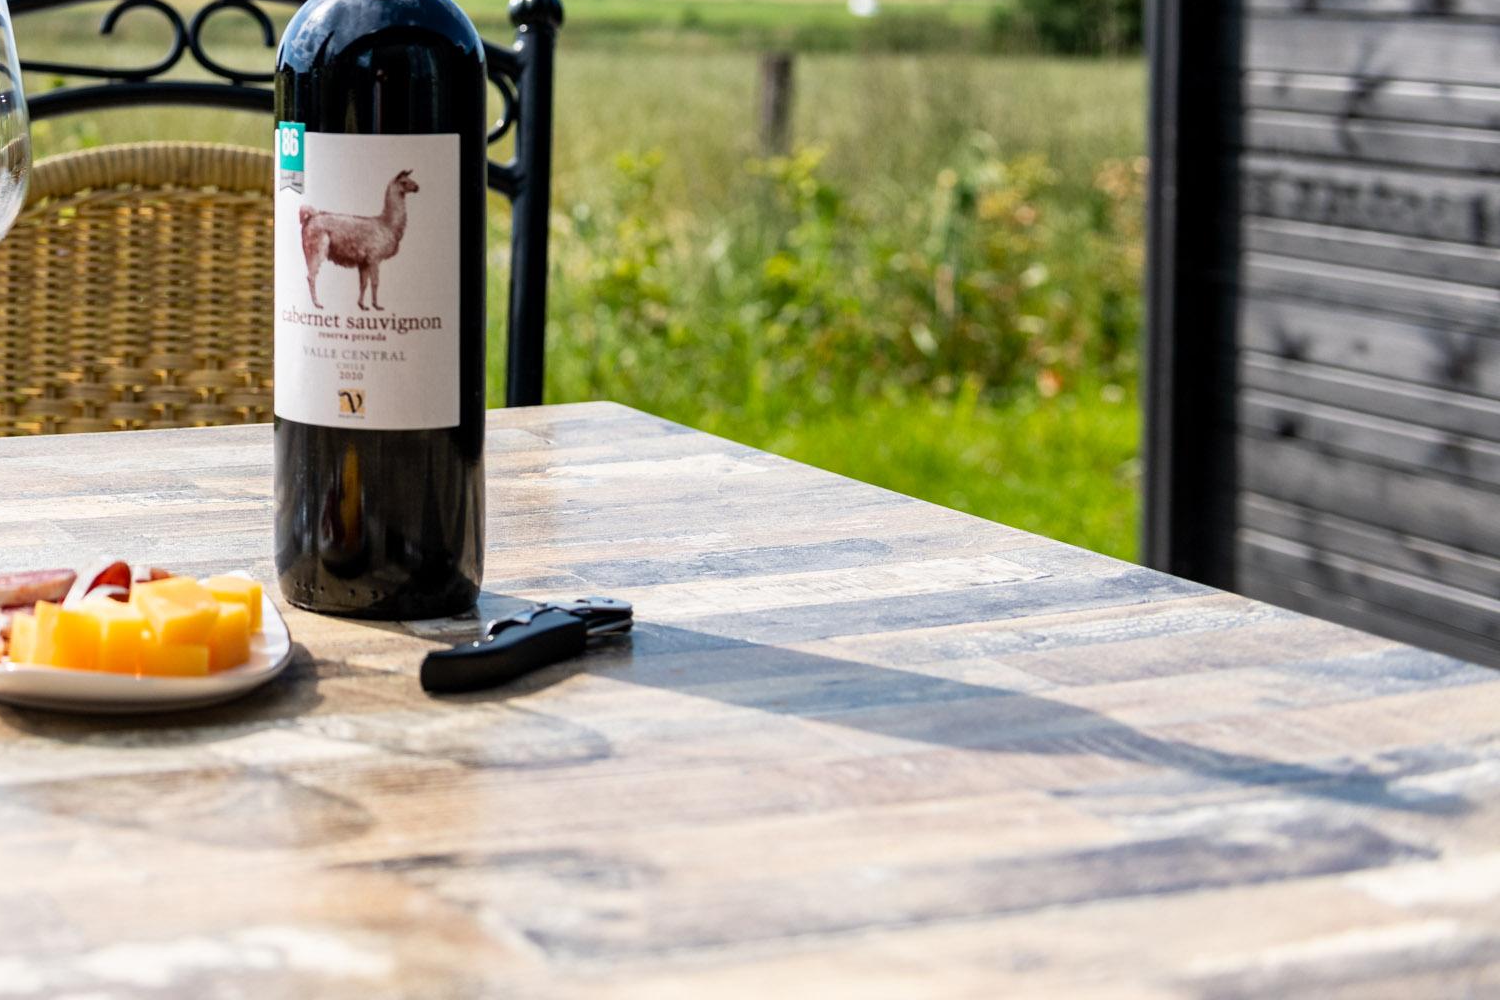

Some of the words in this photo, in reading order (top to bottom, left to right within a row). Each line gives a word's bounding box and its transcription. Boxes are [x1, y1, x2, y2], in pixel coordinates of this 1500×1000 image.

[282, 127, 299, 156] 86
[282, 305, 340, 328] cabernet
[346, 313, 443, 334] sauvignon
[318, 331, 349, 340] reserva
[351, 333, 387, 342] privada
[303, 346, 338, 358] VALLE
[342, 350, 407, 361] CENTRAL
[339, 371, 364, 380] 2020
